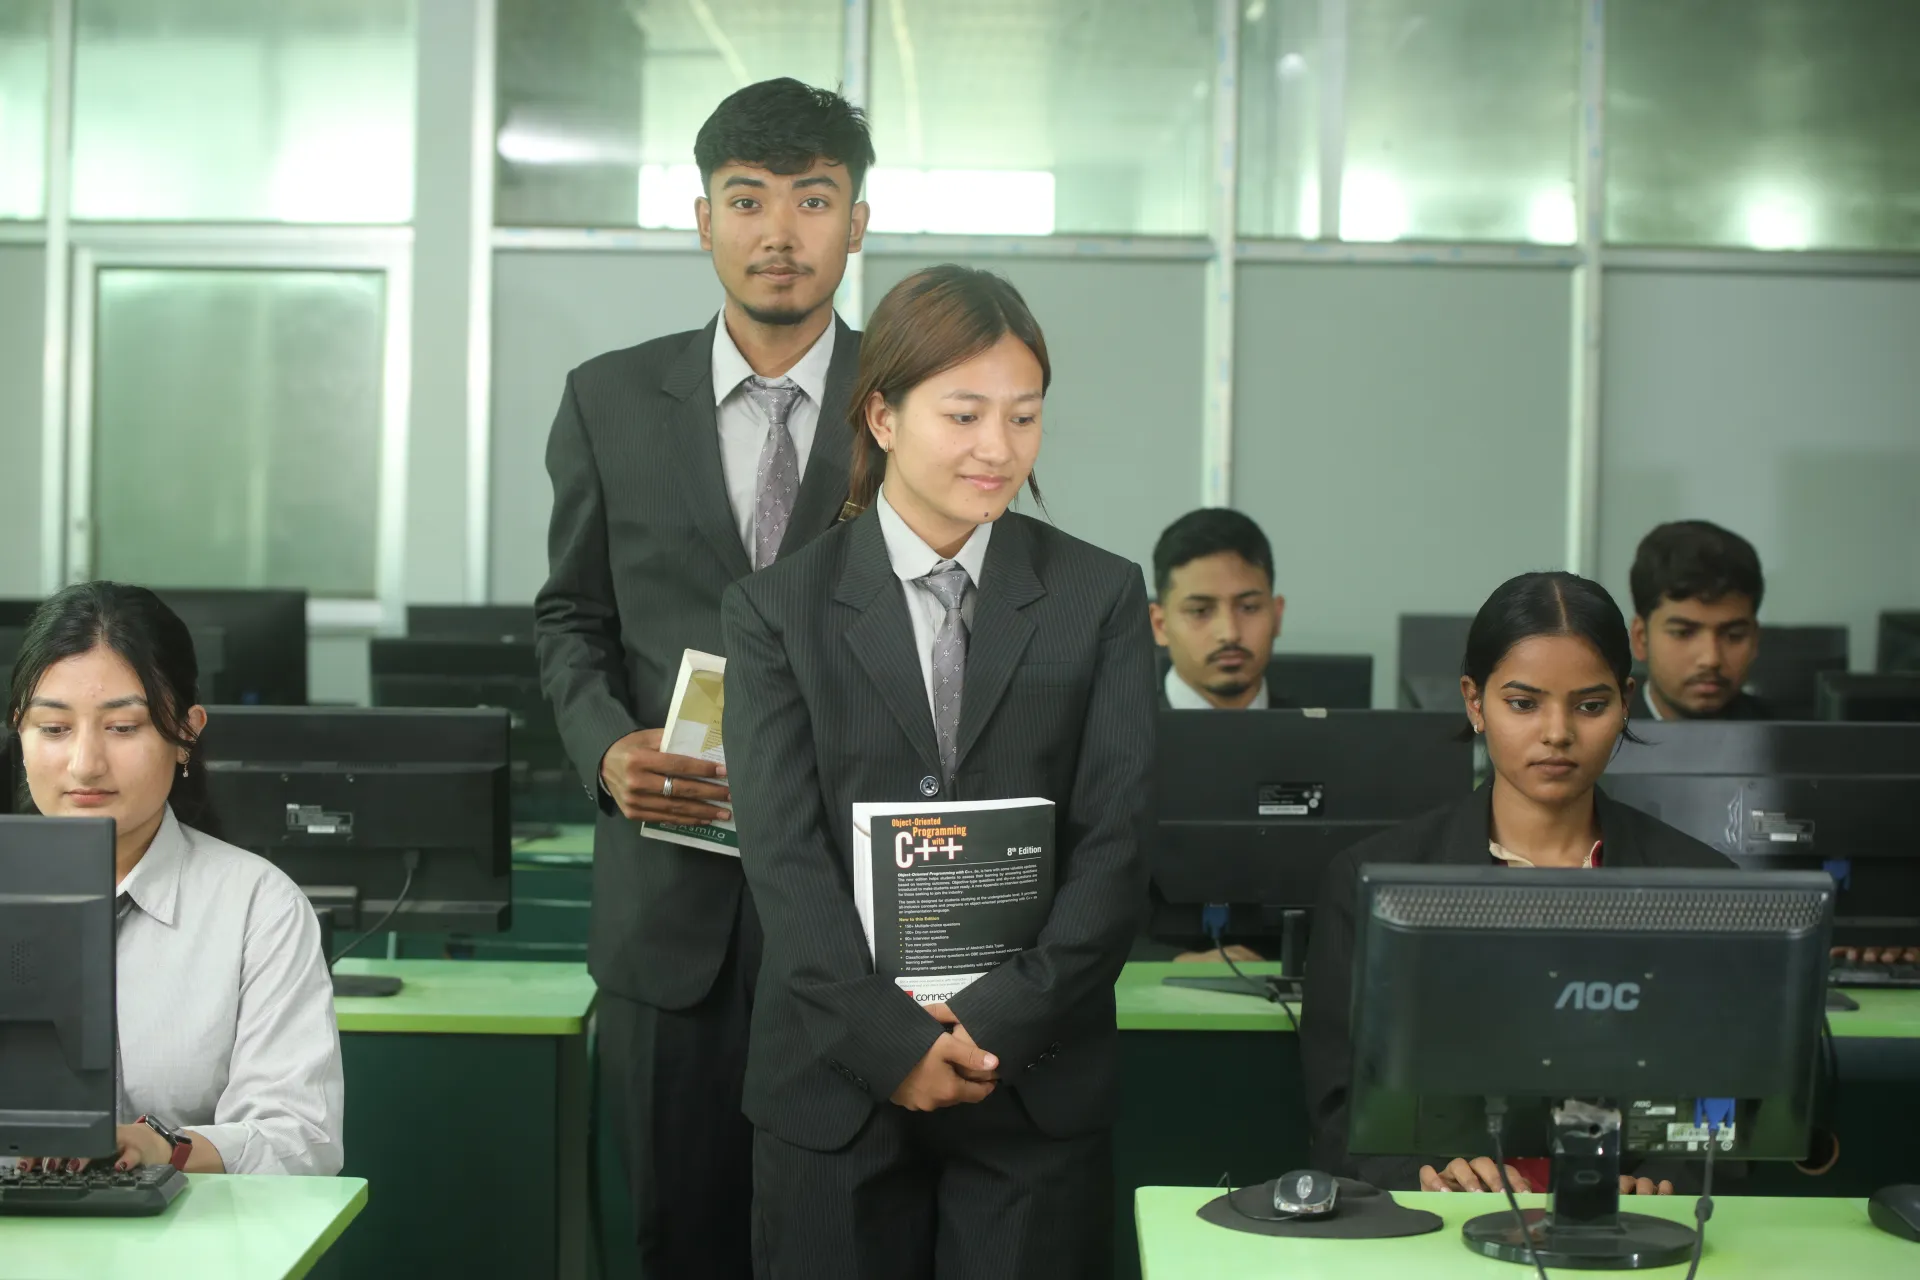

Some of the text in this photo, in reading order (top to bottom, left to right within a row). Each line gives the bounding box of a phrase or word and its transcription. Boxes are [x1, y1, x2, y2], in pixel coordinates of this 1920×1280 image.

[891, 817, 941, 828] Object-Oriented
[912, 825, 967, 839] Programming
[932, 837, 945, 845] with
[895, 831, 963, 869] C++
[1018, 846, 1042, 855] Edition
[1554, 981, 1641, 1011] AOC
